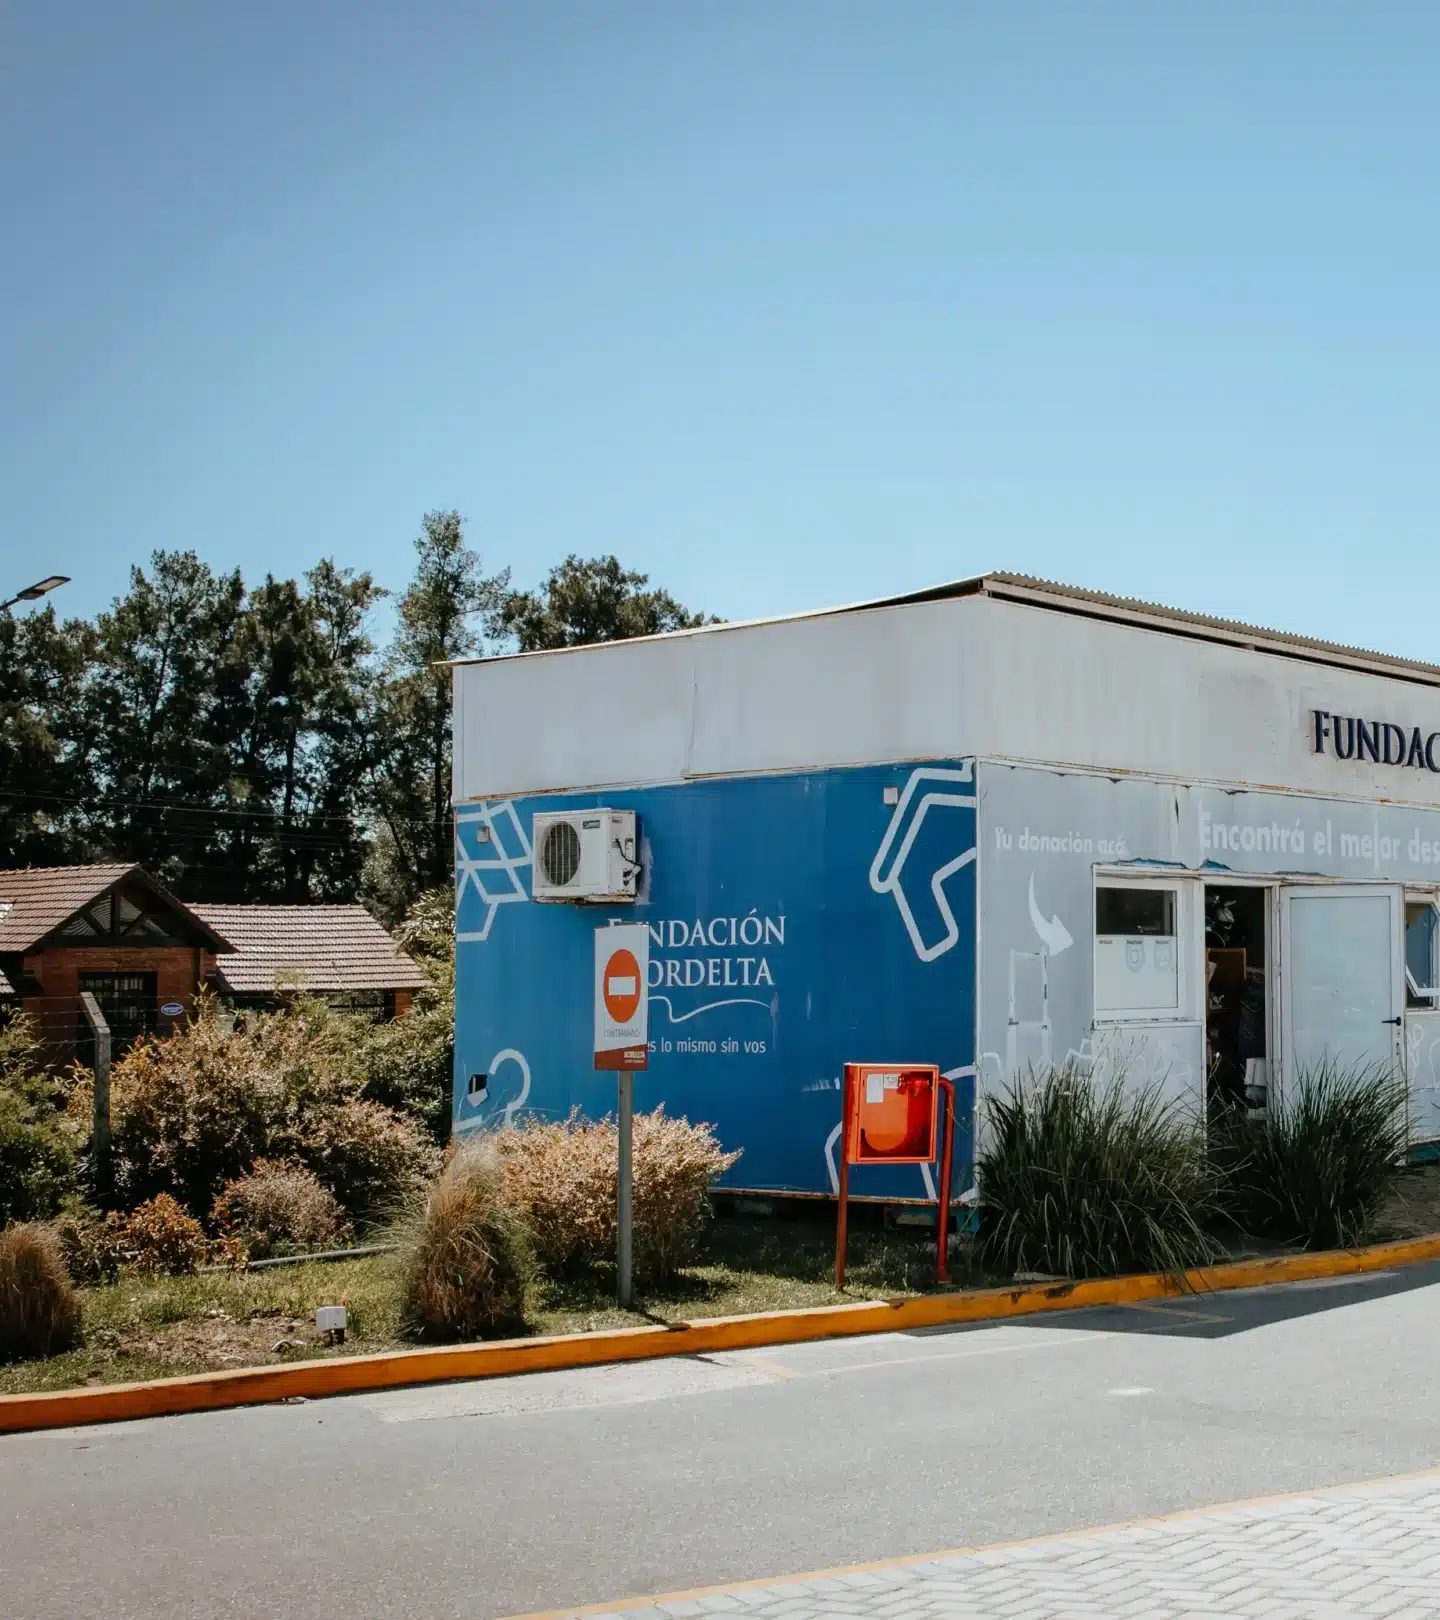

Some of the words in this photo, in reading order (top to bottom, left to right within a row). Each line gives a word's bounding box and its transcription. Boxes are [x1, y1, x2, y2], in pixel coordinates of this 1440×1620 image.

[1018, 825, 1093, 854] donación
[1200, 811, 1305, 854] Encontrá
[1313, 819, 1332, 856] el
[1340, 822, 1400, 868] mejor
[607, 908, 787, 948] NDACIÓN
[648, 956, 776, 988] ORDELTA
[660, 1037, 673, 1053] lo
[676, 1038, 717, 1053] mismo
[720, 1037, 740, 1053] sin
[744, 1040, 766, 1054] vos
